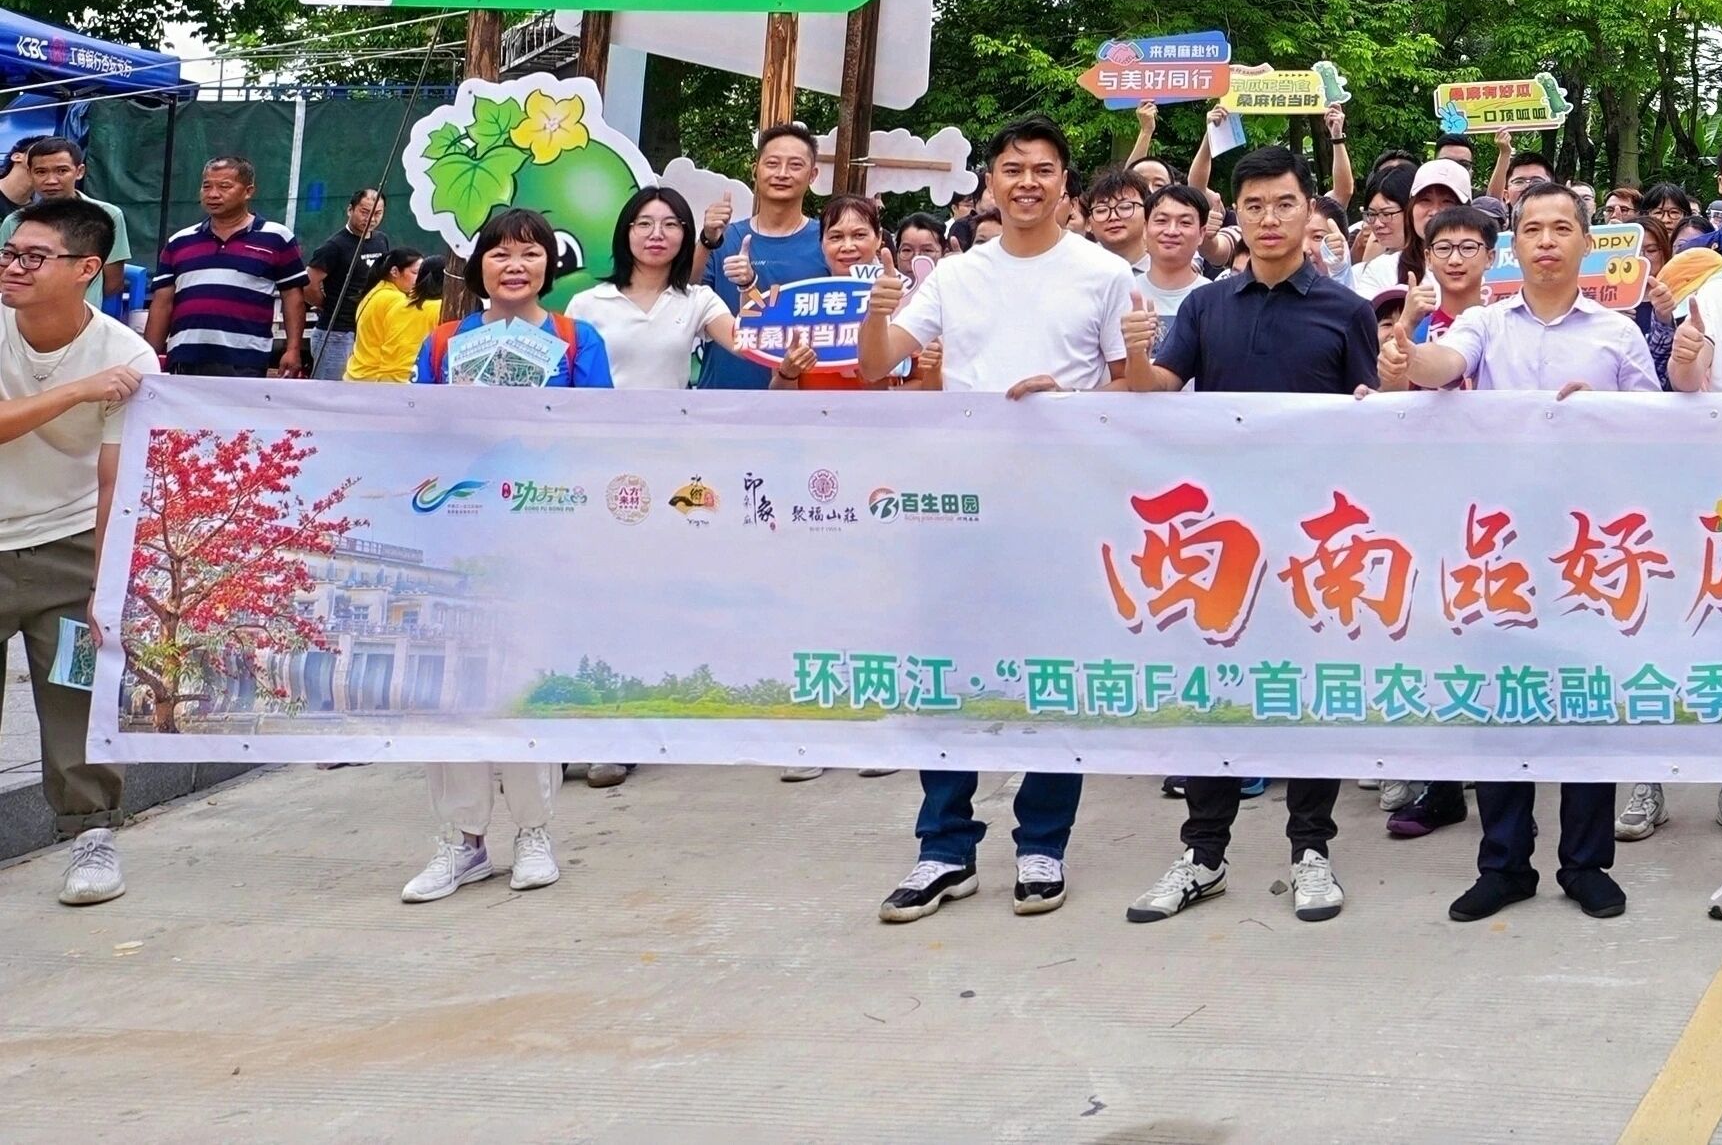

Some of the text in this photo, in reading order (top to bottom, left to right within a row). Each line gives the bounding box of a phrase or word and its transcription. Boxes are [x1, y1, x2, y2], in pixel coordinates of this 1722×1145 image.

[1097, 69, 1213, 91] 与美好同行
[1236, 93, 1320, 107] 桑麻恰当时
[793, 290, 870, 317] 别卷了
[900, 492, 980, 515] 百生田园
